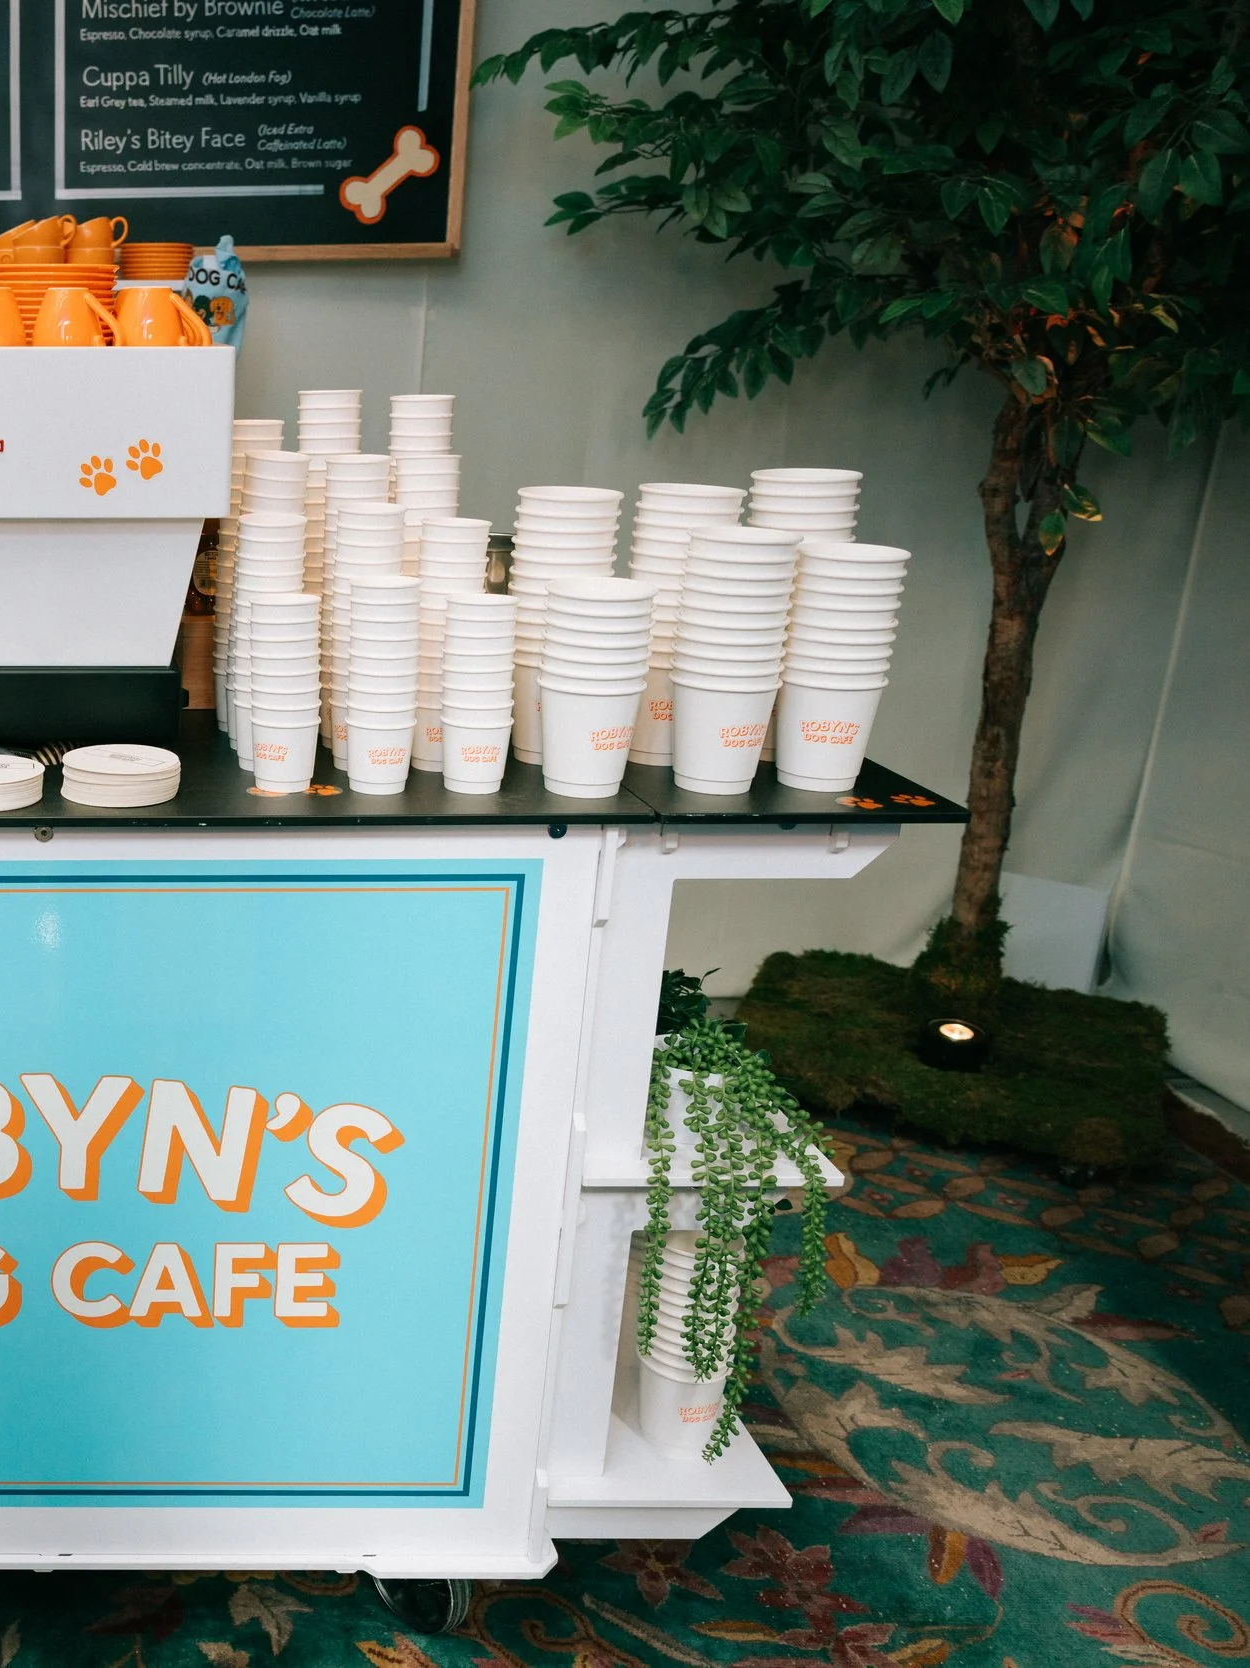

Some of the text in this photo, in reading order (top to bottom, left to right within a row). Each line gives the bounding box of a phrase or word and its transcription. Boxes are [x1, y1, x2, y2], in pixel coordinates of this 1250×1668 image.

[81, 0, 284, 22] Mischief by Brownie
[290, 6, 343, 19] Chocolate
[79, 24, 342, 43] Espresso, Chocolate syrup, Caramel drizzle, Oat milk
[82, 64, 194, 91] Cuppa Tilly
[202, 70, 292, 86] (Hot London Fog)
[79, 95, 99, 108] Earl
[128, 96, 147, 108] tea,
[148, 94, 193, 107] Steamed
[195, 94, 219, 106] milk,
[220, 92, 266, 105] Lavender
[299, 91, 332, 104] Vanilla
[334, 93, 362, 106] syrup
[257, 123, 314, 137] (Iced Extra
[80, 127, 246, 154] Riley's Bitey Face
[257, 137, 315, 152] Caffeinated
[79, 161, 126, 175] Espresso,
[127, 160, 153, 172] Cold
[154, 160, 179, 171] brew
[180, 160, 243, 172] concentrate,
[244, 158, 265, 170] Oat
[291, 157, 322, 169] Brown
[324, 159, 352, 171] sugar
[800, 720, 860, 735] ROBYN'S
[593, 742, 615, 751] DOG
[723, 738, 745, 748] DOG
[804, 734, 854, 745] DOG CAFE
[368, 747, 406, 758] ROBYN'S
[461, 744, 501, 756] ROBYN'S
[370, 756, 387, 765] DOG
[463, 755, 498, 763] DOG CAFE
[51, 1240, 341, 1329] CAFE
